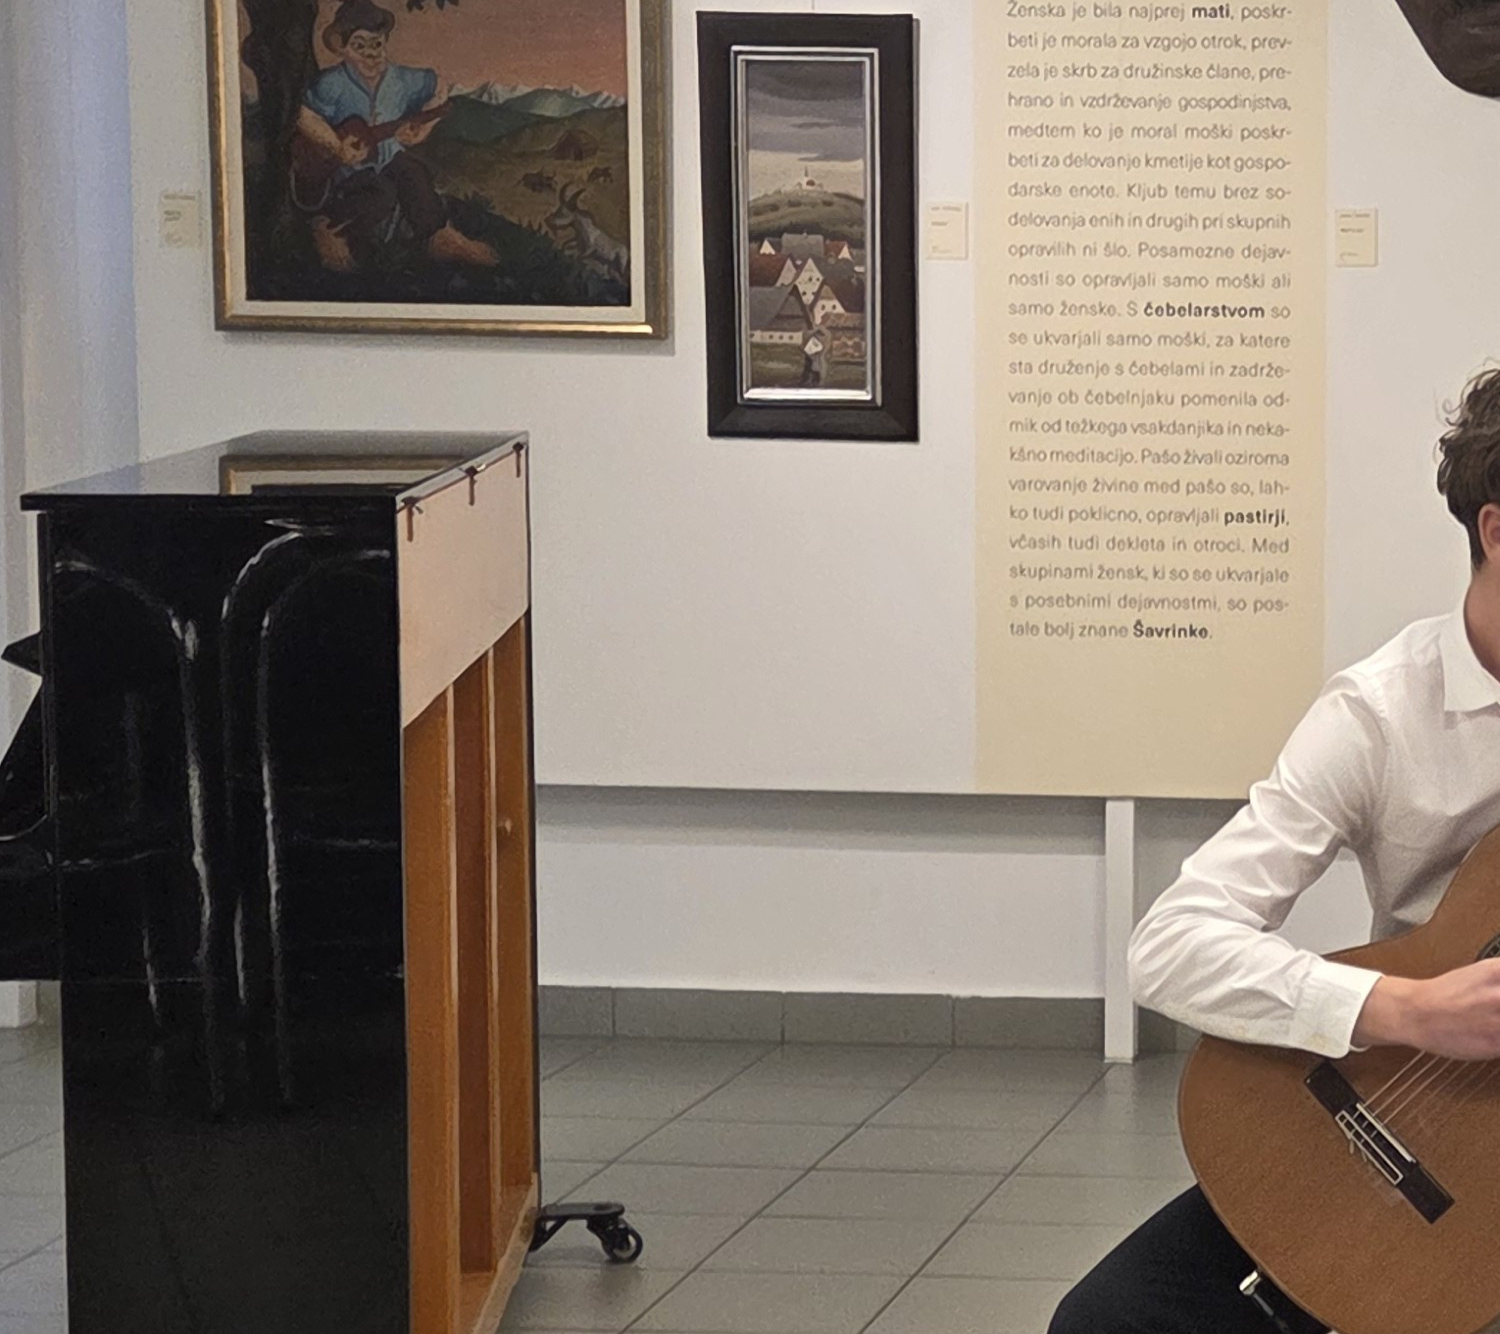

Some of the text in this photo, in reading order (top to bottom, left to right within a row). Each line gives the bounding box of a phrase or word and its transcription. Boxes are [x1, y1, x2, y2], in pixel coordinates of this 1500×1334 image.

[1071, 2, 1087, 22] je
[1093, 2, 1122, 18] bila
[1128, 3, 1186, 23] najprej
[1007, 32, 1038, 47] beti
[1041, 32, 1057, 52] je
[1061, 32, 1117, 48] morala
[1121, 37, 1140, 48] za
[1143, 33, 1197, 53] vzgojo
[1007, 62, 1040, 78] zela
[1043, 63, 1058, 82] je
[1062, 62, 1097, 78] skrb
[1100, 67, 1119, 78] za
[1008, 92, 1054, 108] hrano
[1059, 93, 1072, 108] in
[1008, 122, 1075, 138] medtem
[1083, 122, 1102, 138] ko
[1108, 123, 1124, 143] je
[1130, 122, 1177, 138] moral
[1184, 123, 1233, 138] moški
[1008, 152, 1038, 167] beti
[1041, 156, 1060, 167] za
[1144, 152, 1203, 173] kmetije
[1206, 153, 1231, 168] kot
[1008, 181, 1062, 197] darske
[1126, 182, 1168, 202] Kljub
[1175, 182, 1216, 198] temu
[1223, 183, 1259, 198] brez
[1089, 212, 1124, 228] enih
[1127, 213, 1142, 228] in
[1145, 212, 1199, 233] drugih
[1202, 213, 1223, 233] pri
[1226, 213, 1291, 233] skupnih
[1083, 242, 1097, 257] ni
[1008, 270, 1049, 286] nosti
[1055, 275, 1075, 286] so
[1162, 276, 1209, 287] samo
[1215, 272, 1265, 288] moški
[1271, 272, 1291, 288] ali
[1008, 304, 1054, 316] samo
[1126, 301, 1138, 317] S
[1270, 307, 1291, 318] so
[1008, 333, 1028, 344] se
[1105, 334, 1152, 346] samo
[1215, 335, 1234, 346] za
[1239, 331, 1291, 347] katere
[1008, 360, 1033, 376] sta
[1038, 360, 1110, 381] druženje
[1114, 366, 1124, 377] s
[1128, 361, 1205, 377] čebelami
[1209, 362, 1225, 377] in
[1008, 390, 1052, 410] vanje
[1057, 390, 1079, 405] ob
[1180, 391, 1257, 412] pomenila
[1008, 418, 1038, 433] mik
[1041, 418, 1061, 434] od
[1065, 418, 1127, 439] težkega
[1227, 420, 1242, 435] in
[1008, 446, 1047, 462] kšno
[1141, 448, 1180, 464] Pašo
[1183, 448, 1222, 464] živali
[1225, 449, 1289, 465] oziroma
[1092, 477, 1138, 492] živine
[1143, 477, 1180, 493] med
[1185, 478, 1226, 498] pašo
[1009, 504, 1029, 520] ko
[1032, 504, 1064, 520] tudi
[1009, 534, 1062, 550] včasih
[1068, 534, 1100, 550] tudi
[1105, 535, 1165, 551] dekleta
[1172, 536, 1187, 551] in
[1251, 536, 1289, 552] Med
[1152, 565, 1166, 580] ki
[1169, 570, 1189, 581] so
[1192, 570, 1212, 581] se
[1009, 597, 1019, 608] s
[1227, 599, 1247, 610] so
[1009, 621, 1040, 637] tale
[1044, 621, 1075, 642] bolj
[1078, 626, 1128, 638] znane
